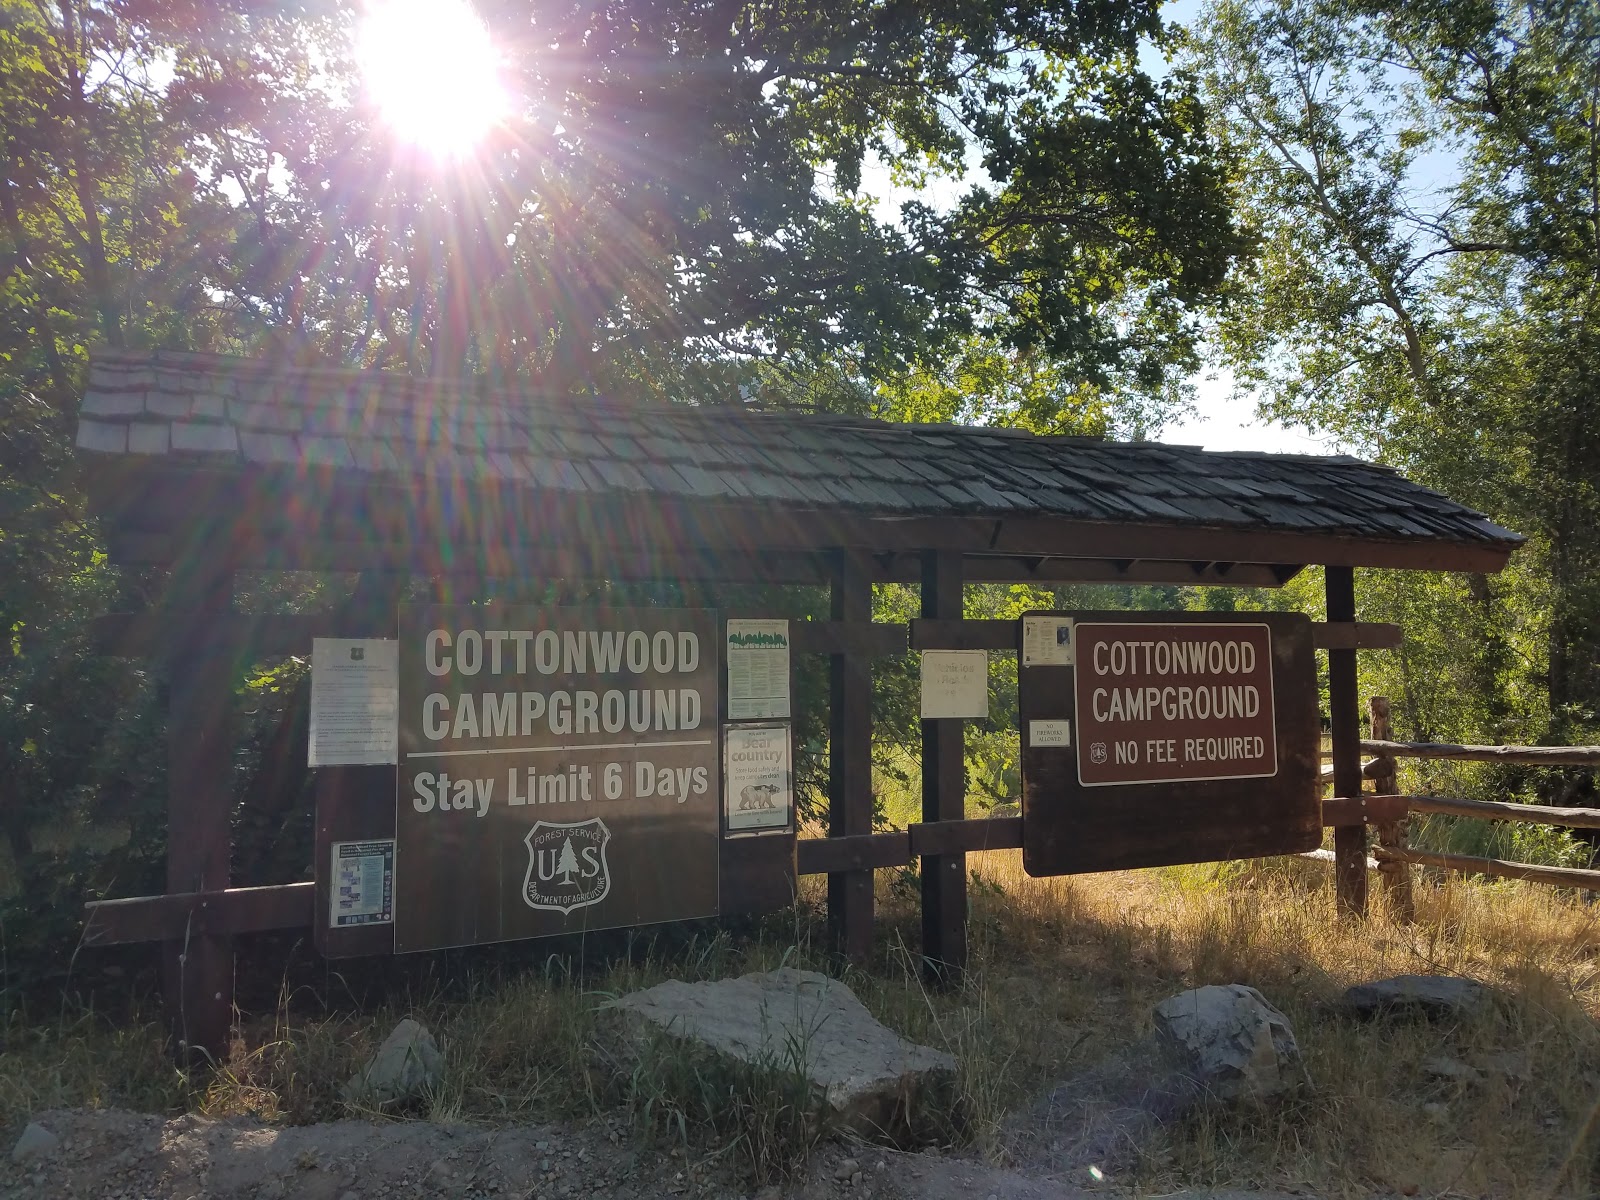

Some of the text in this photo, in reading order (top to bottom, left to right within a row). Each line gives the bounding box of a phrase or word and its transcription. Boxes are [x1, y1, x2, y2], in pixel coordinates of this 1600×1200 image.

[425, 629, 700, 676] COTTONWOOD
[1093, 640, 1256, 676] COTTONWOOD
[422, 688, 701, 741] CAMPGROUND
[1092, 685, 1260, 722] CAMPGROUND
[731, 749, 783, 763] country
[1115, 736, 1265, 765] NO FEE REQUIRED
[412, 761, 708, 818] Stay Limit 6 Days
[534, 828, 602, 847] FOREST SERVICE
[528, 875, 606, 905] DEPARTMENT OF AGRICULTURE
